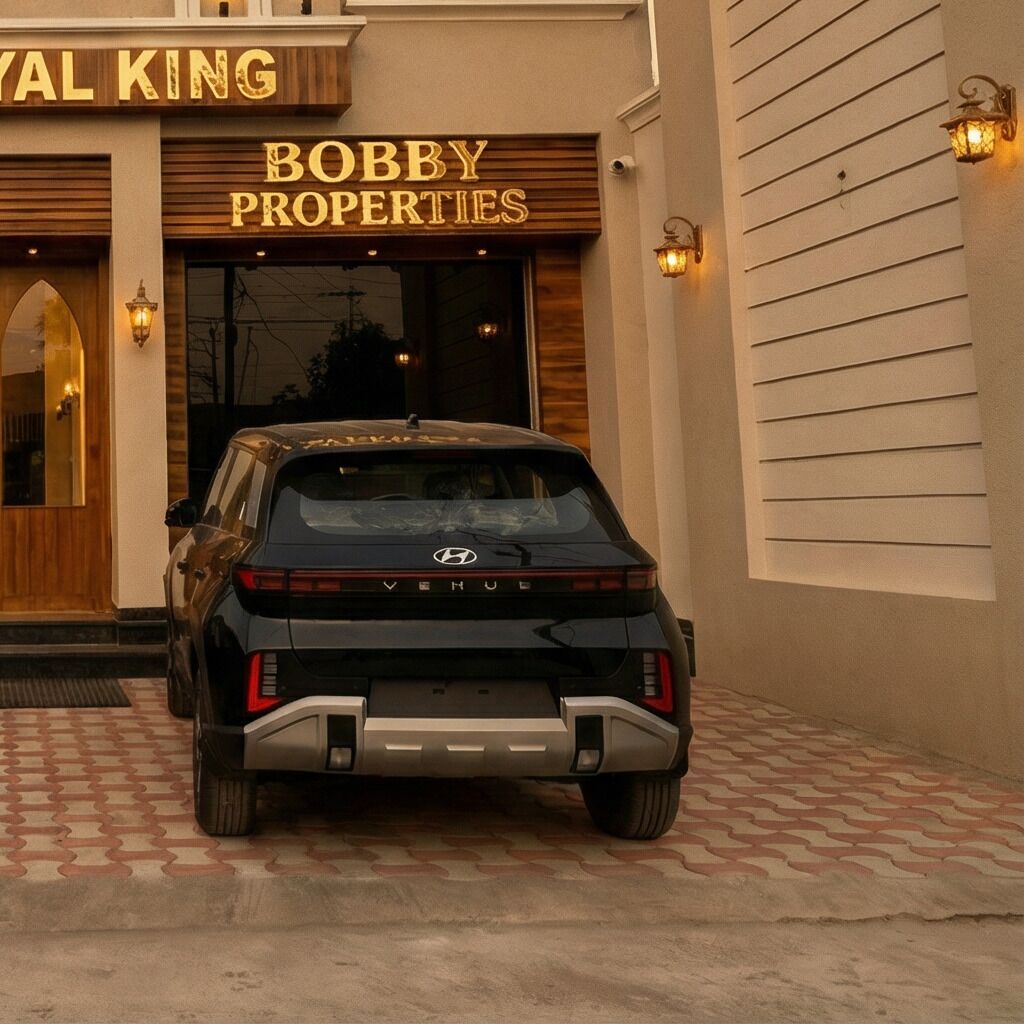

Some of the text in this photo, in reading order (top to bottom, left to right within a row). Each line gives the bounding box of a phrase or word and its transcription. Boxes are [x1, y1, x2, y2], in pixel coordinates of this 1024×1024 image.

[117, 49, 277, 100] KING
[263, 140, 488, 183] BOBBY
[230, 188, 529, 227] PROPERTIES
